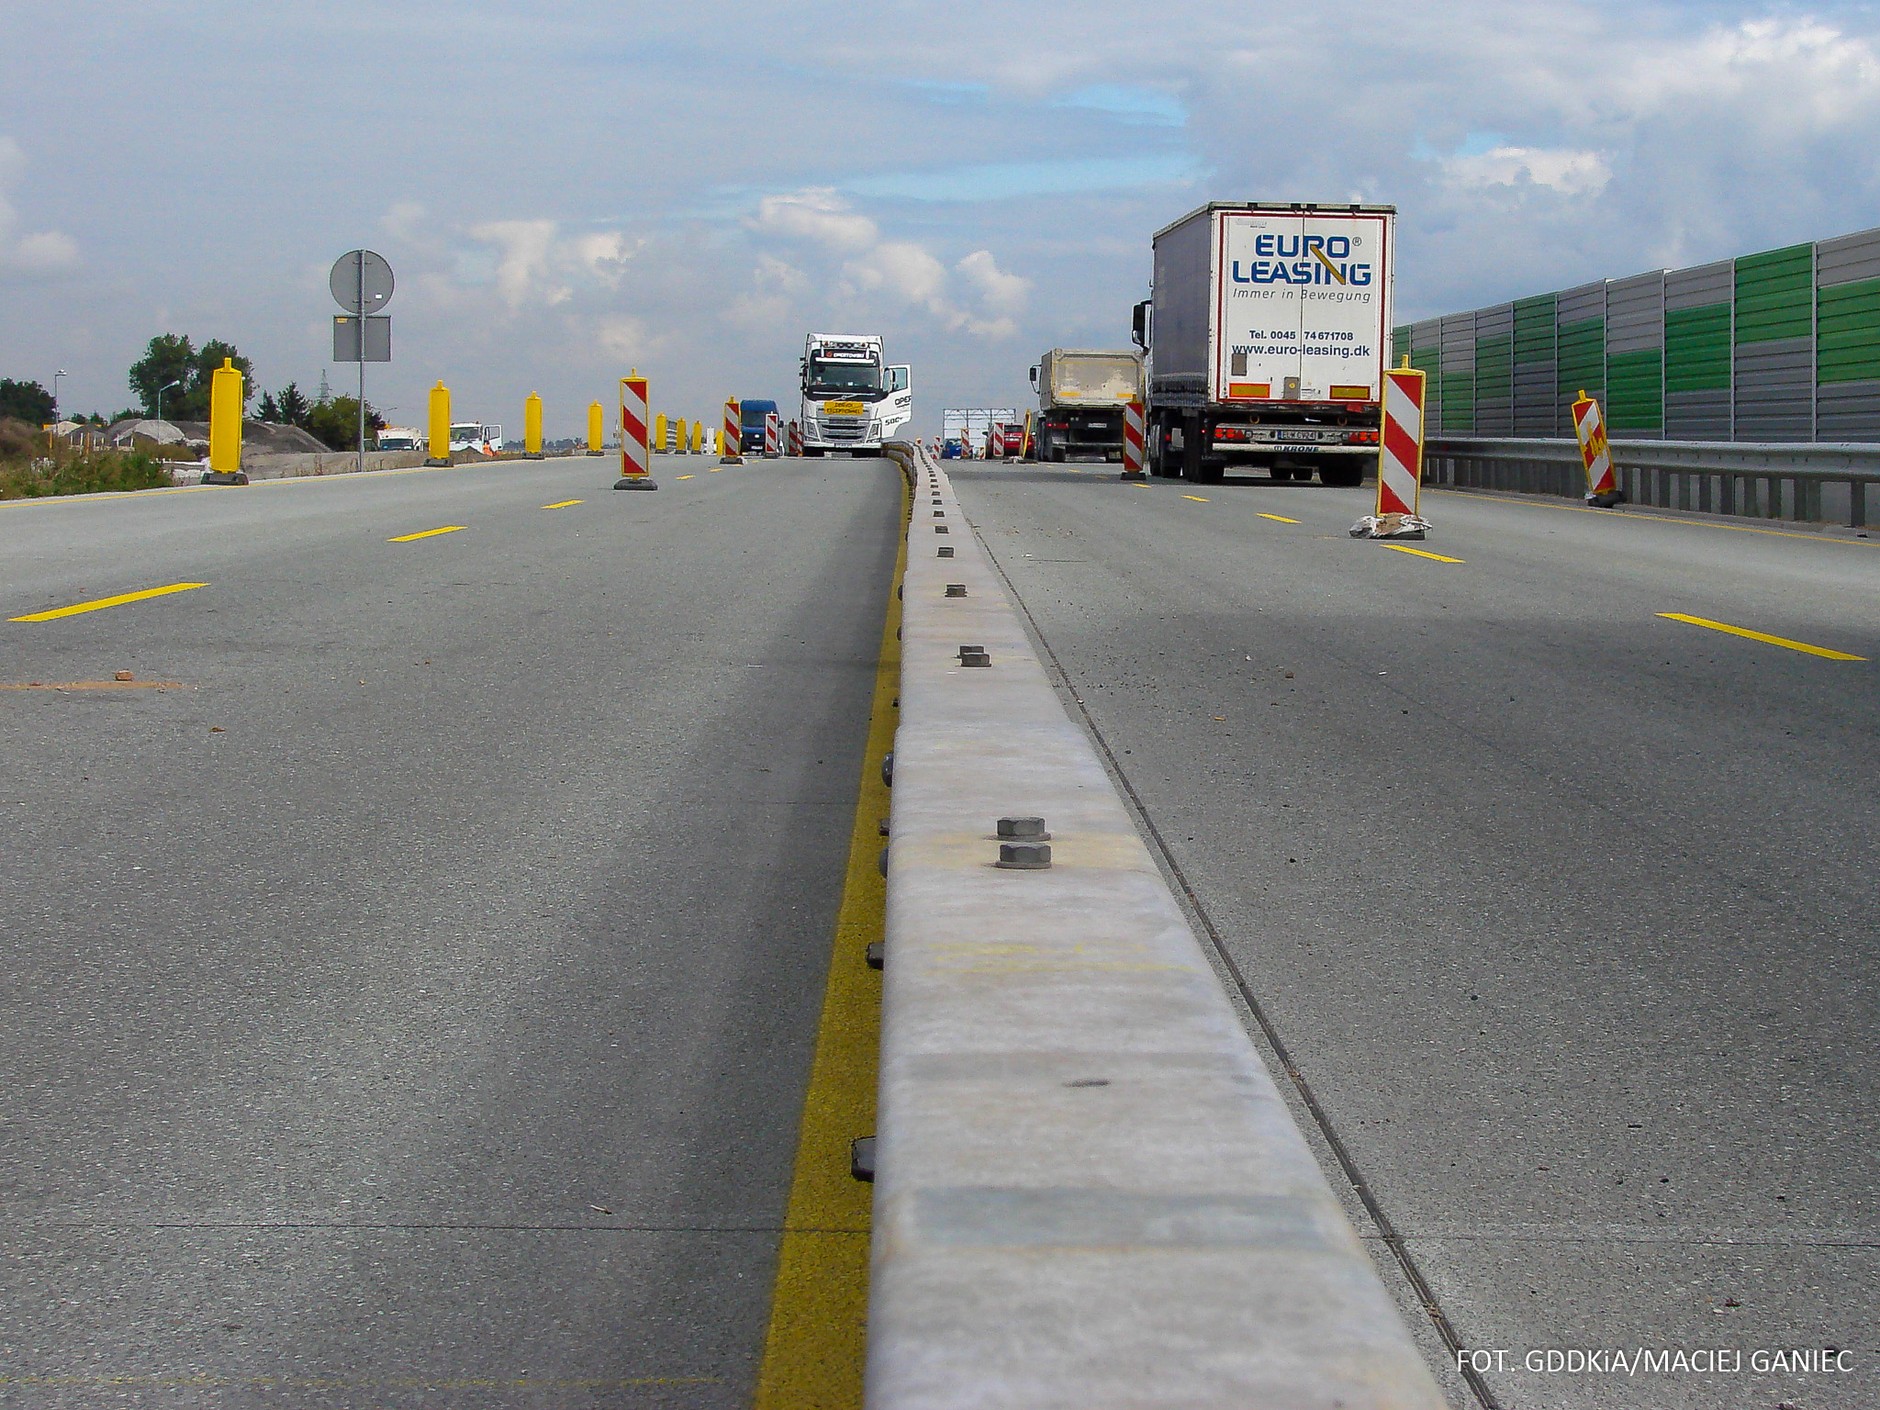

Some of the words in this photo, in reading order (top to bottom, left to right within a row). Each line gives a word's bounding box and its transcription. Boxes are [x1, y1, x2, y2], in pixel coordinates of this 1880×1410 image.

[1255, 234, 1350, 258] EURO
[1233, 261, 1371, 286] LEASING
[1233, 287, 1275, 299] Immer
[1281, 288, 1294, 299] in
[1301, 289, 1371, 303] Bewegung
[1249, 330, 1268, 340] Tel.
[1270, 331, 1296, 340] 0045
[1232, 344, 1370, 358] www.euro-leasing.dk
